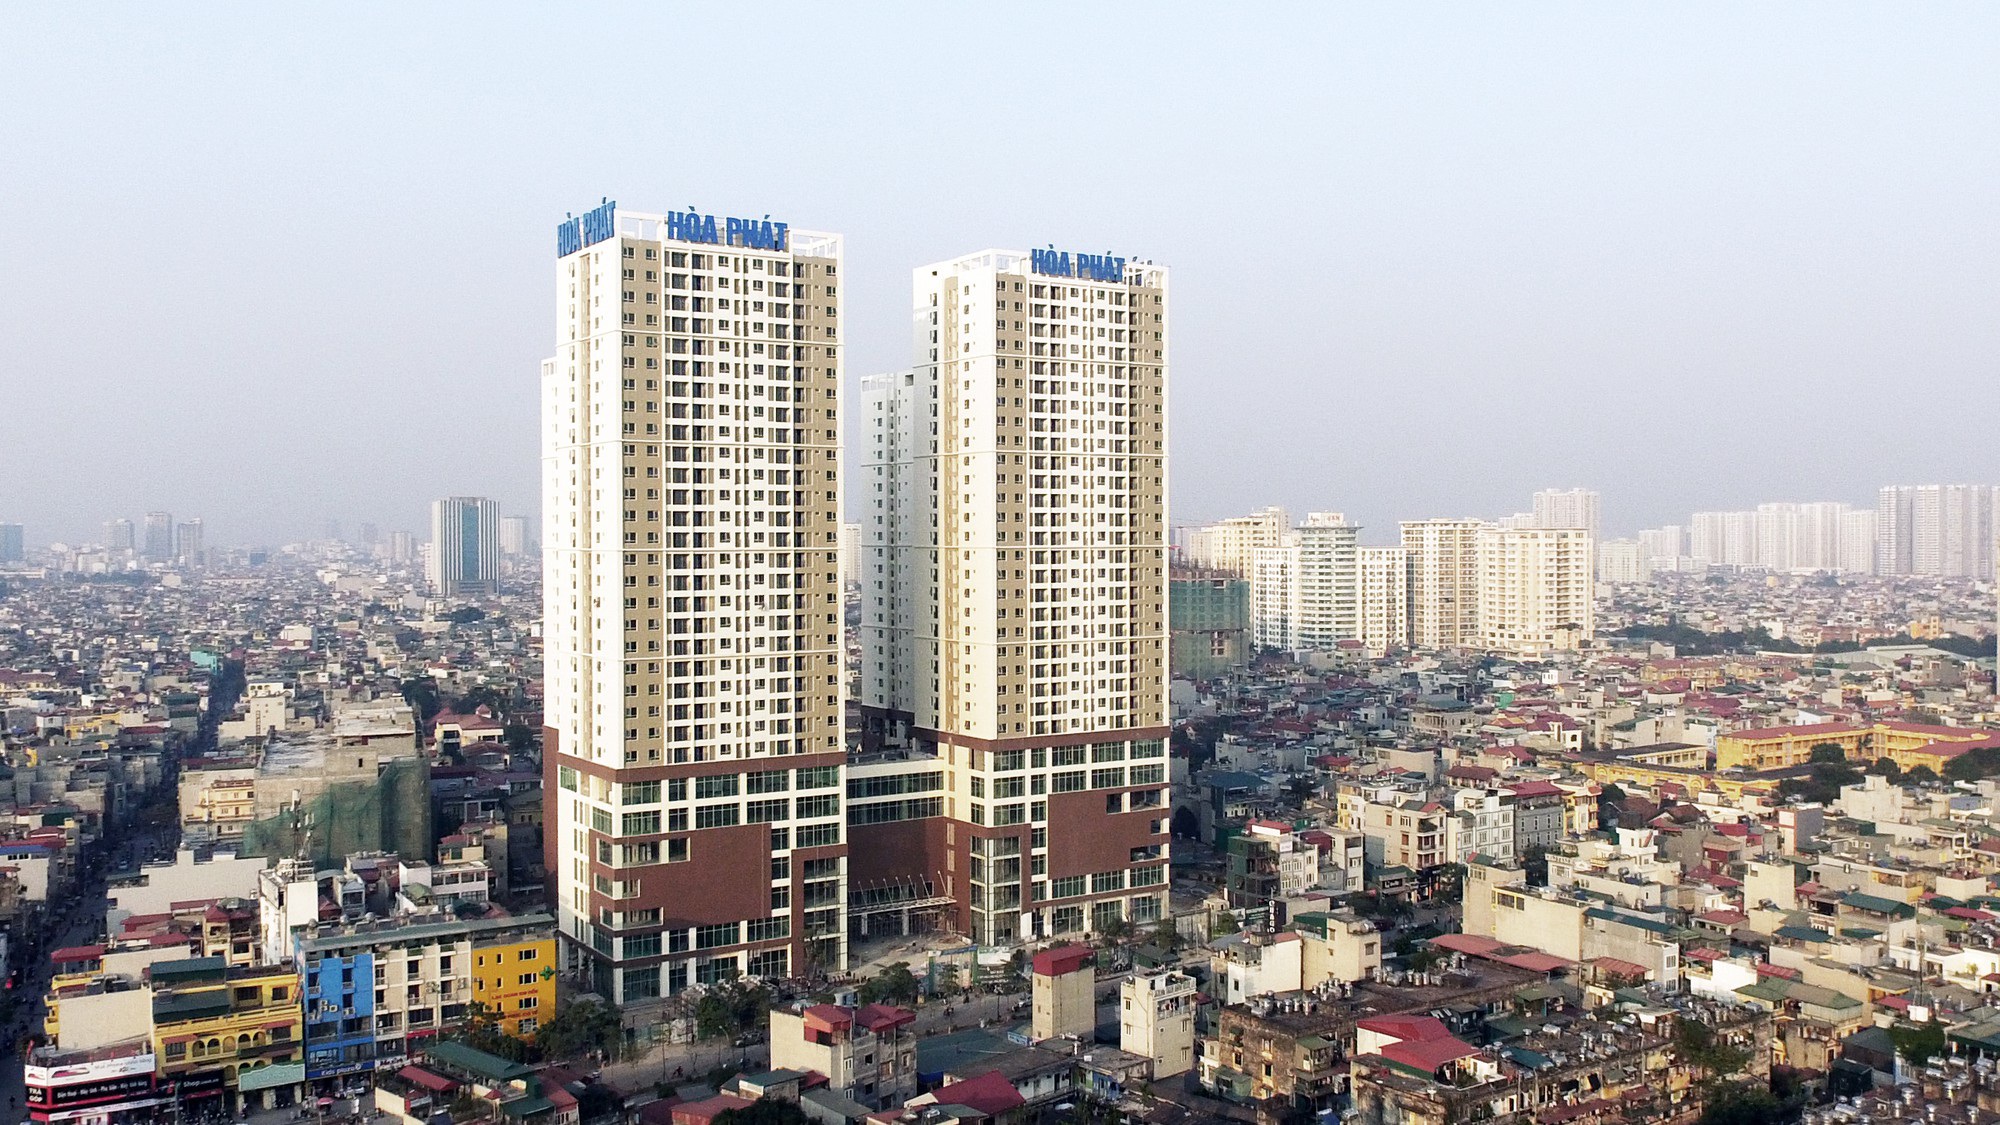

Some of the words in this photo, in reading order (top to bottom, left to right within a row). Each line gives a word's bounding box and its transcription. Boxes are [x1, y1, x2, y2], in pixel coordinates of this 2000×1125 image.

[557, 212, 582, 259] HÒA
[583, 196, 616, 248] PHÁT
[667, 205, 718, 245] HÒA
[726, 214, 788, 252] PHÁT
[1031, 243, 1071, 278] HÒA
[1076, 250, 1125, 283] PHÁT
